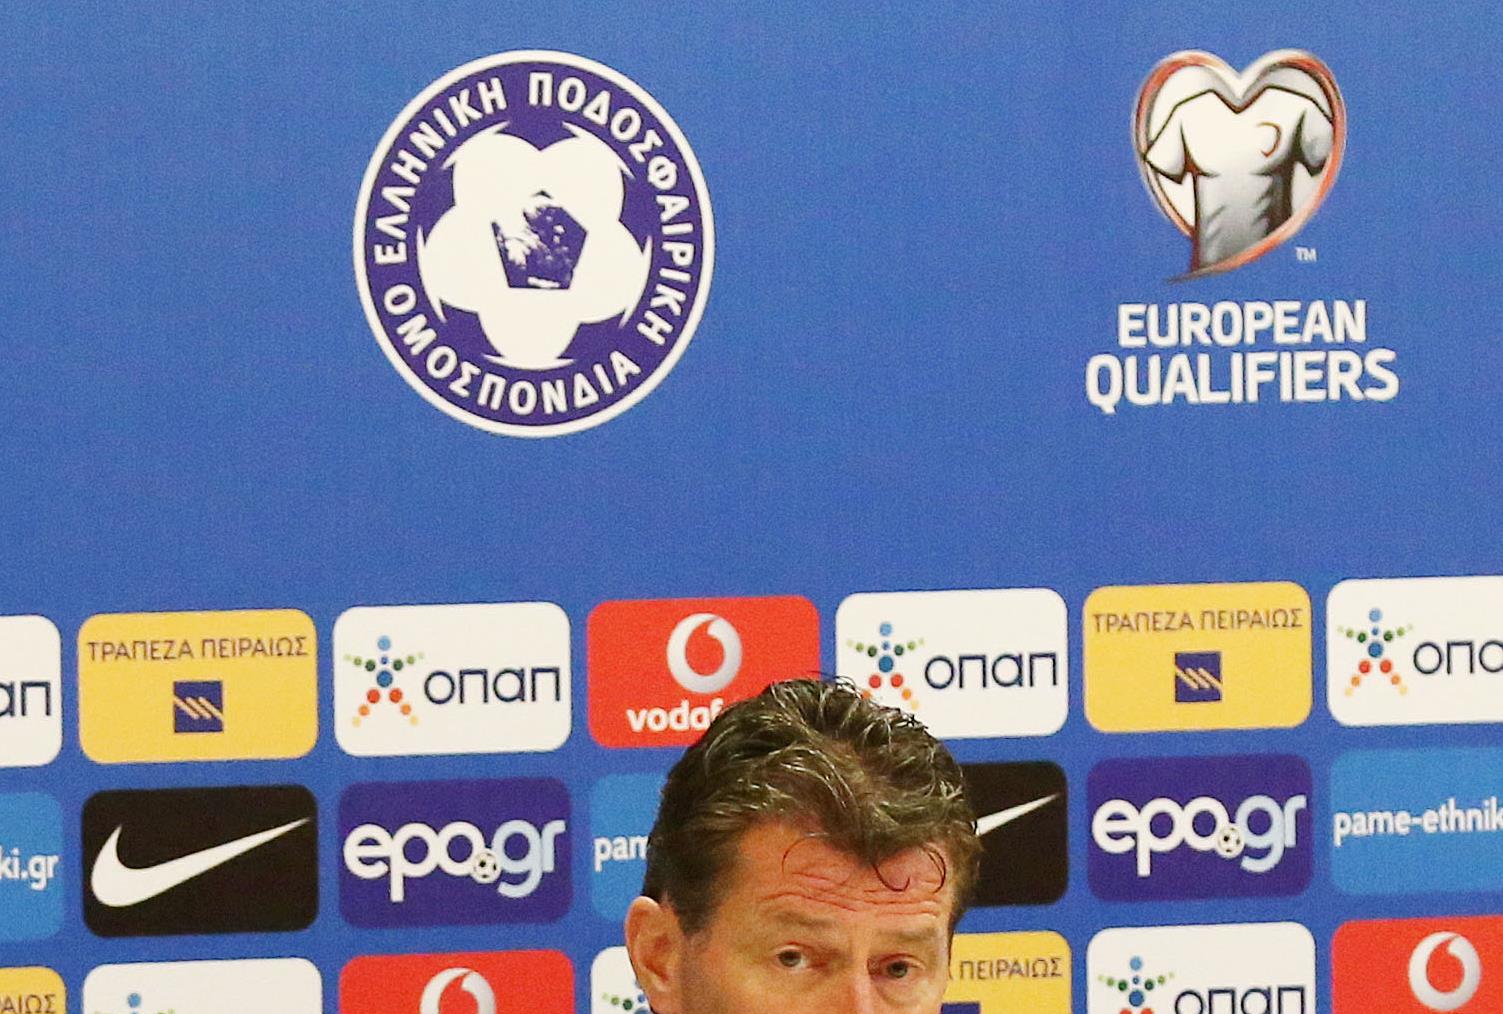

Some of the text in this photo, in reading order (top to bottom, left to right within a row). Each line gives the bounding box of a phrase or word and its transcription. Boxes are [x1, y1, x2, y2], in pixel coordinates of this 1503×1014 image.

[374, 72, 694, 415] ΕΛΛΗΝΙΚΗ ΠΟΔΟΣΦΑΙΡΙΚΗ ΟΜΟΣΠΟΝΔΙΑ
[1118, 300, 1367, 347] EUROPEAN
[1086, 347, 1400, 414] QUALIFIERS
[1093, 608, 1304, 634] ΤΡΑΠΕΖΑ ΠΕΙΡΑΙΩΣ
[87, 636, 308, 662] ΤΡΑΠΕΖΑ ΠΕΙΡΑΙΩΣ
[626, 697, 724, 733] vodaf
[1333, 795, 1503, 847] pame-ethnik
[959, 957, 1063, 981] ΠΕΙΡΑΙΩΣ
